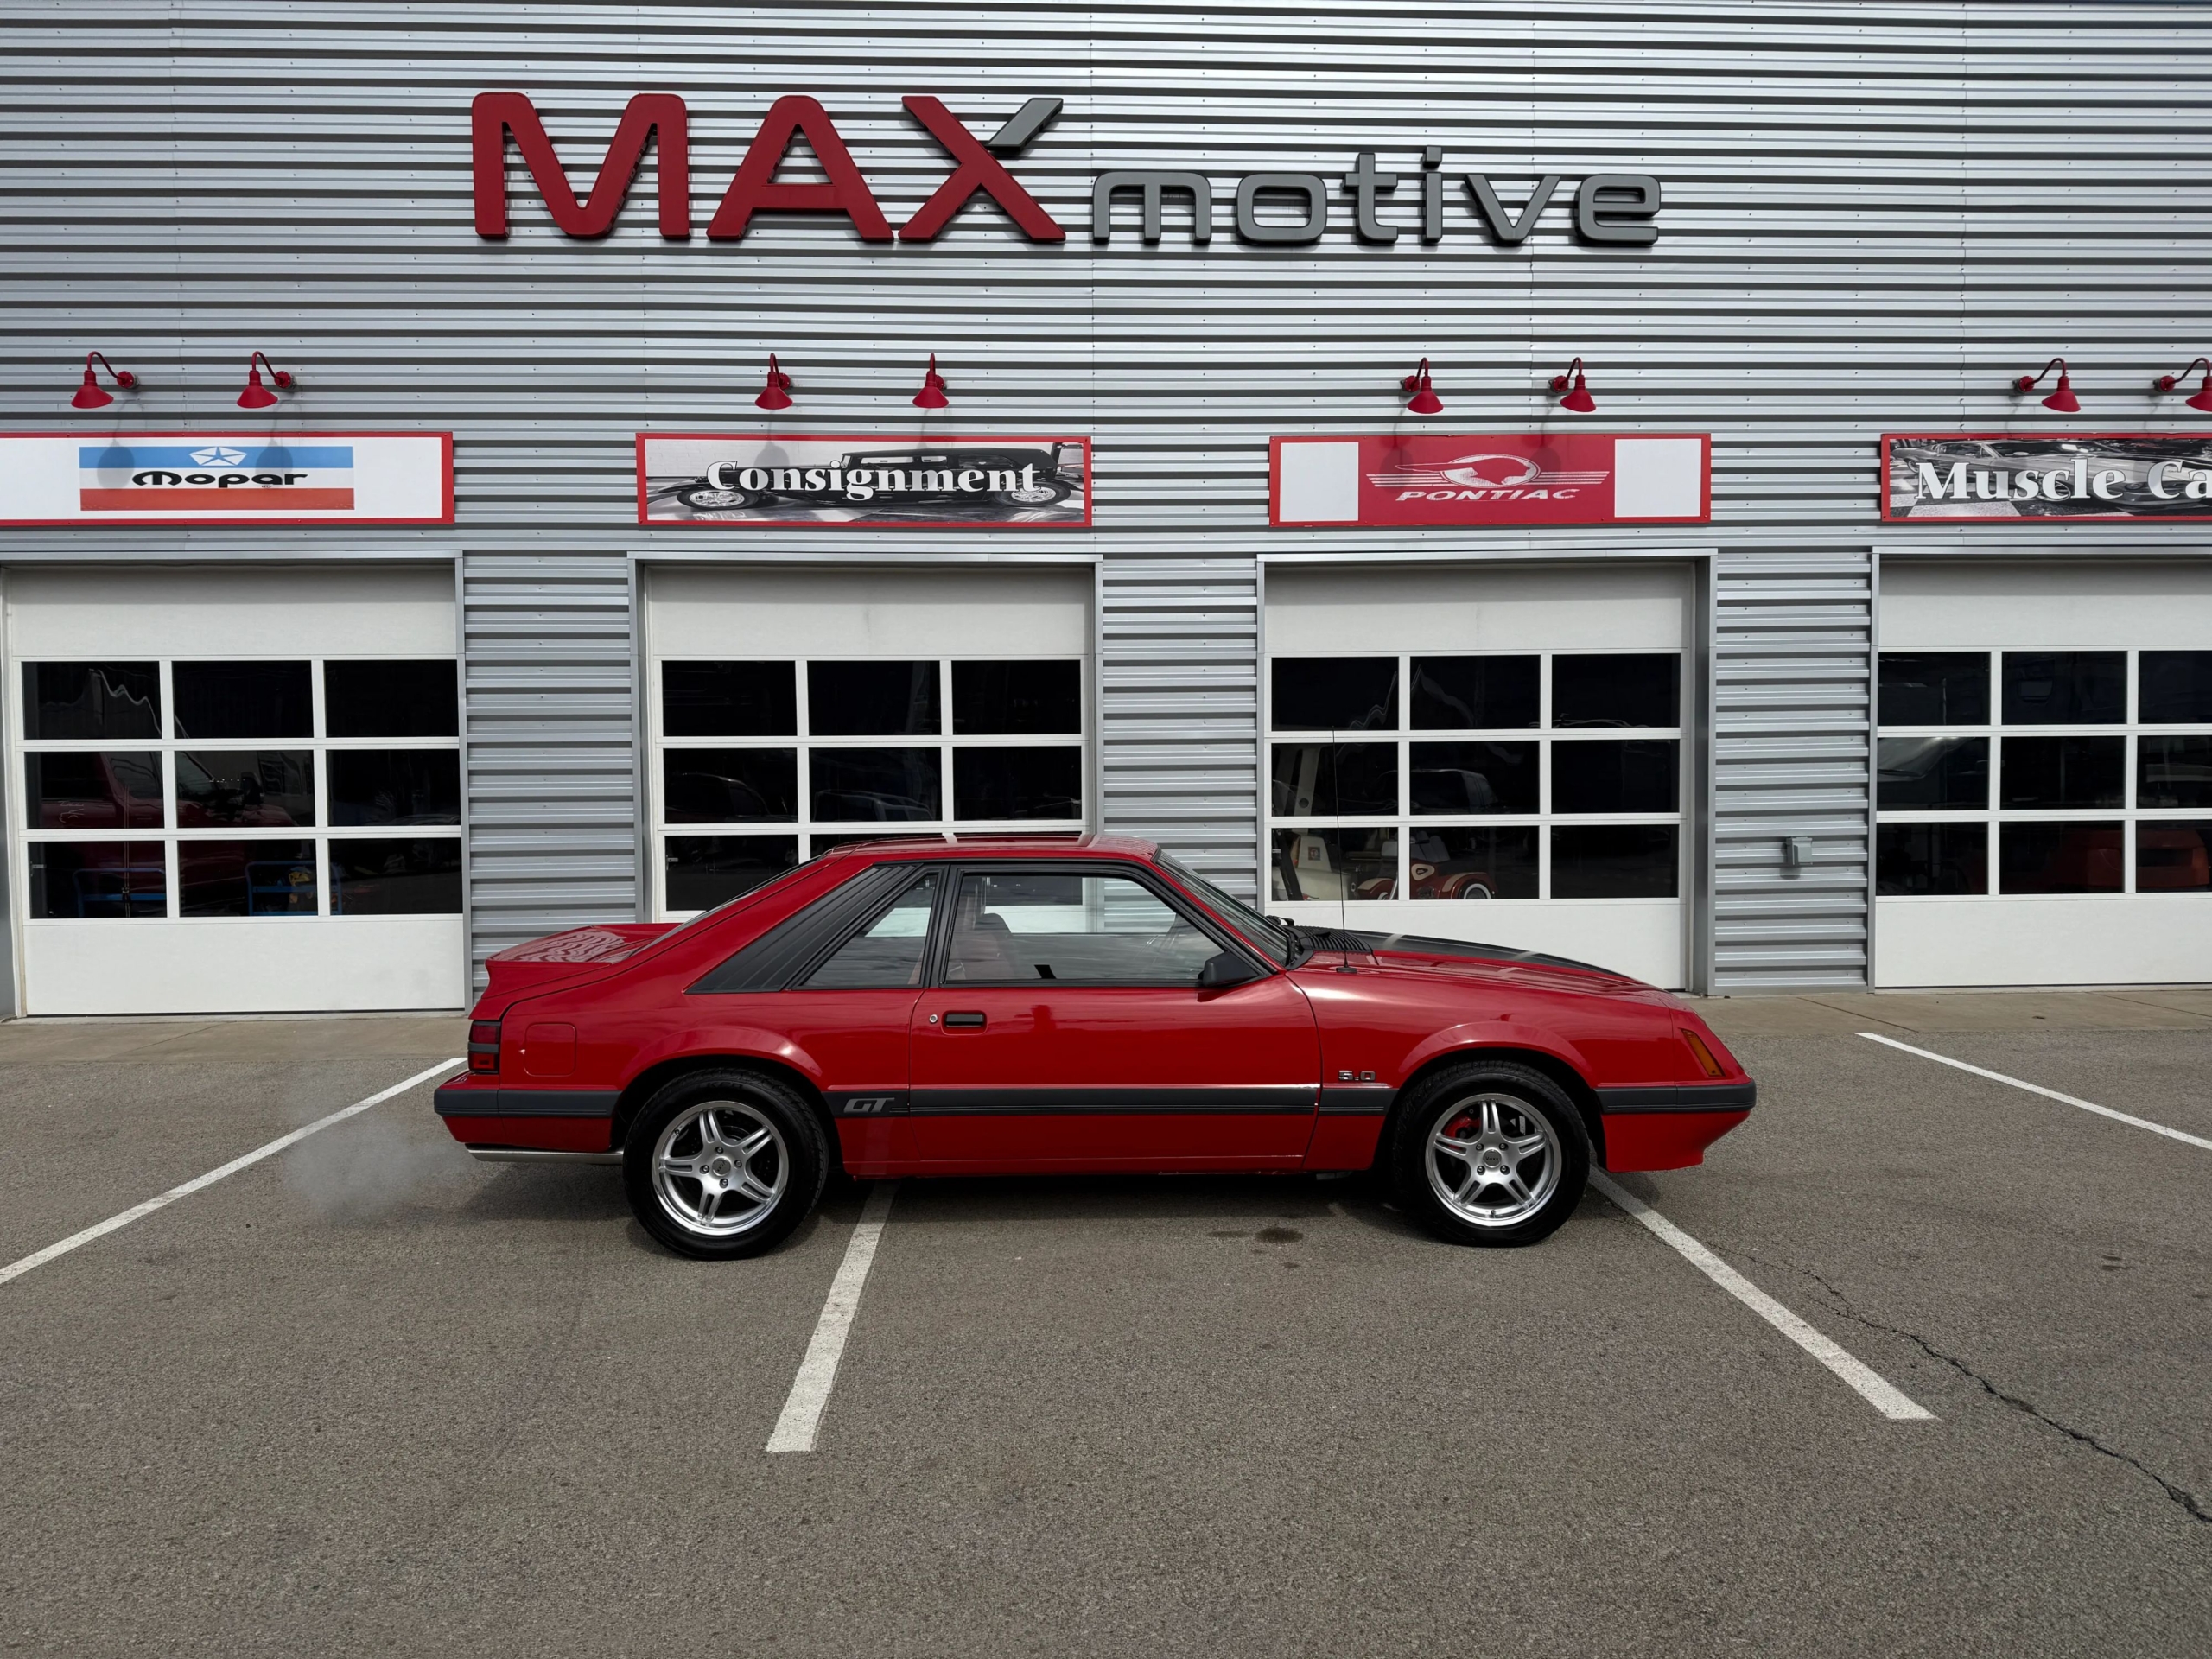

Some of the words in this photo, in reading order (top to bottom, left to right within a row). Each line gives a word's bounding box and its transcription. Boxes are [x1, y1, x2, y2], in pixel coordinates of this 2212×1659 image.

[706, 460, 1041, 501] Consignment
[1914, 458, 2126, 500] Muscle
[1395, 488, 1581, 501] PONTIAC
[1338, 1070, 1376, 1082] 5.0
[843, 1096, 895, 1113] GT
